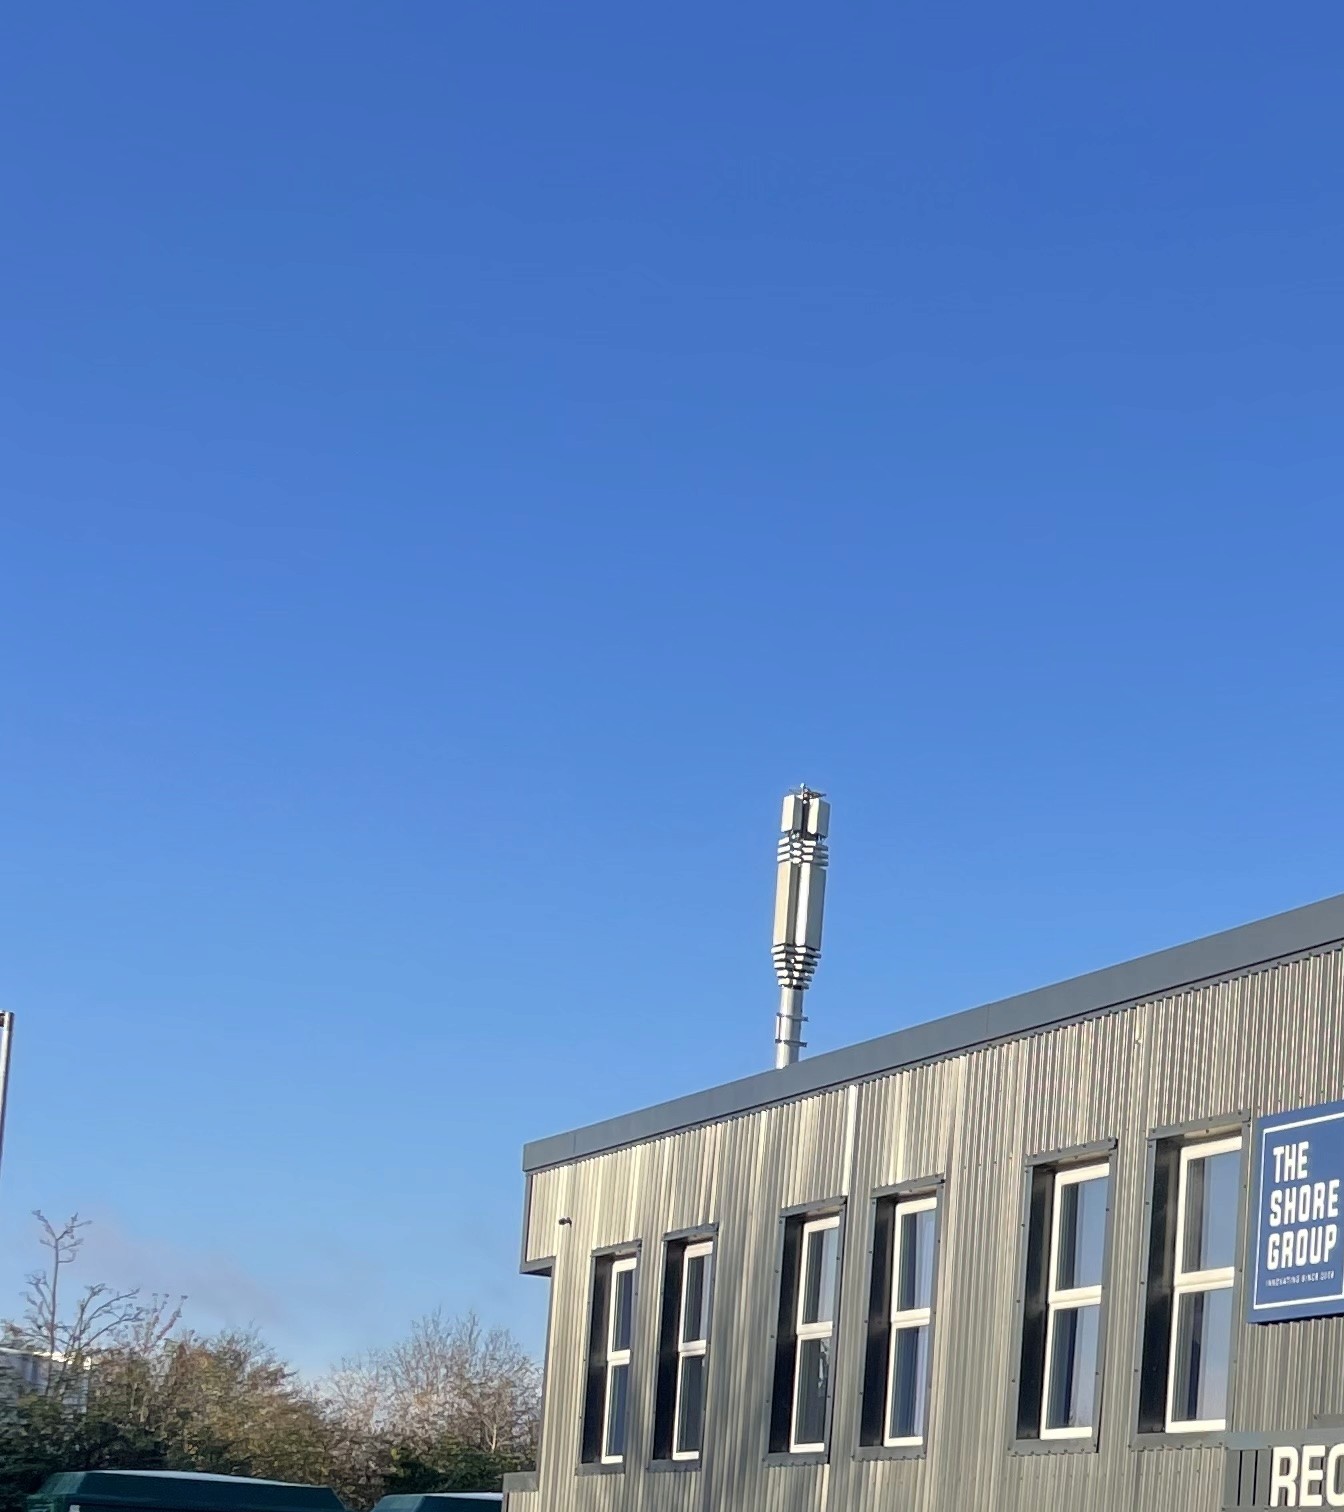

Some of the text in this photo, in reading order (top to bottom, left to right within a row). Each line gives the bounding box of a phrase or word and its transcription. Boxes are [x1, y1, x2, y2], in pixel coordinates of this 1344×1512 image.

[1273, 1141, 1309, 1183] THE
[1269, 1179, 1340, 1227] SHORE
[1267, 1224, 1337, 1271] GROUP
